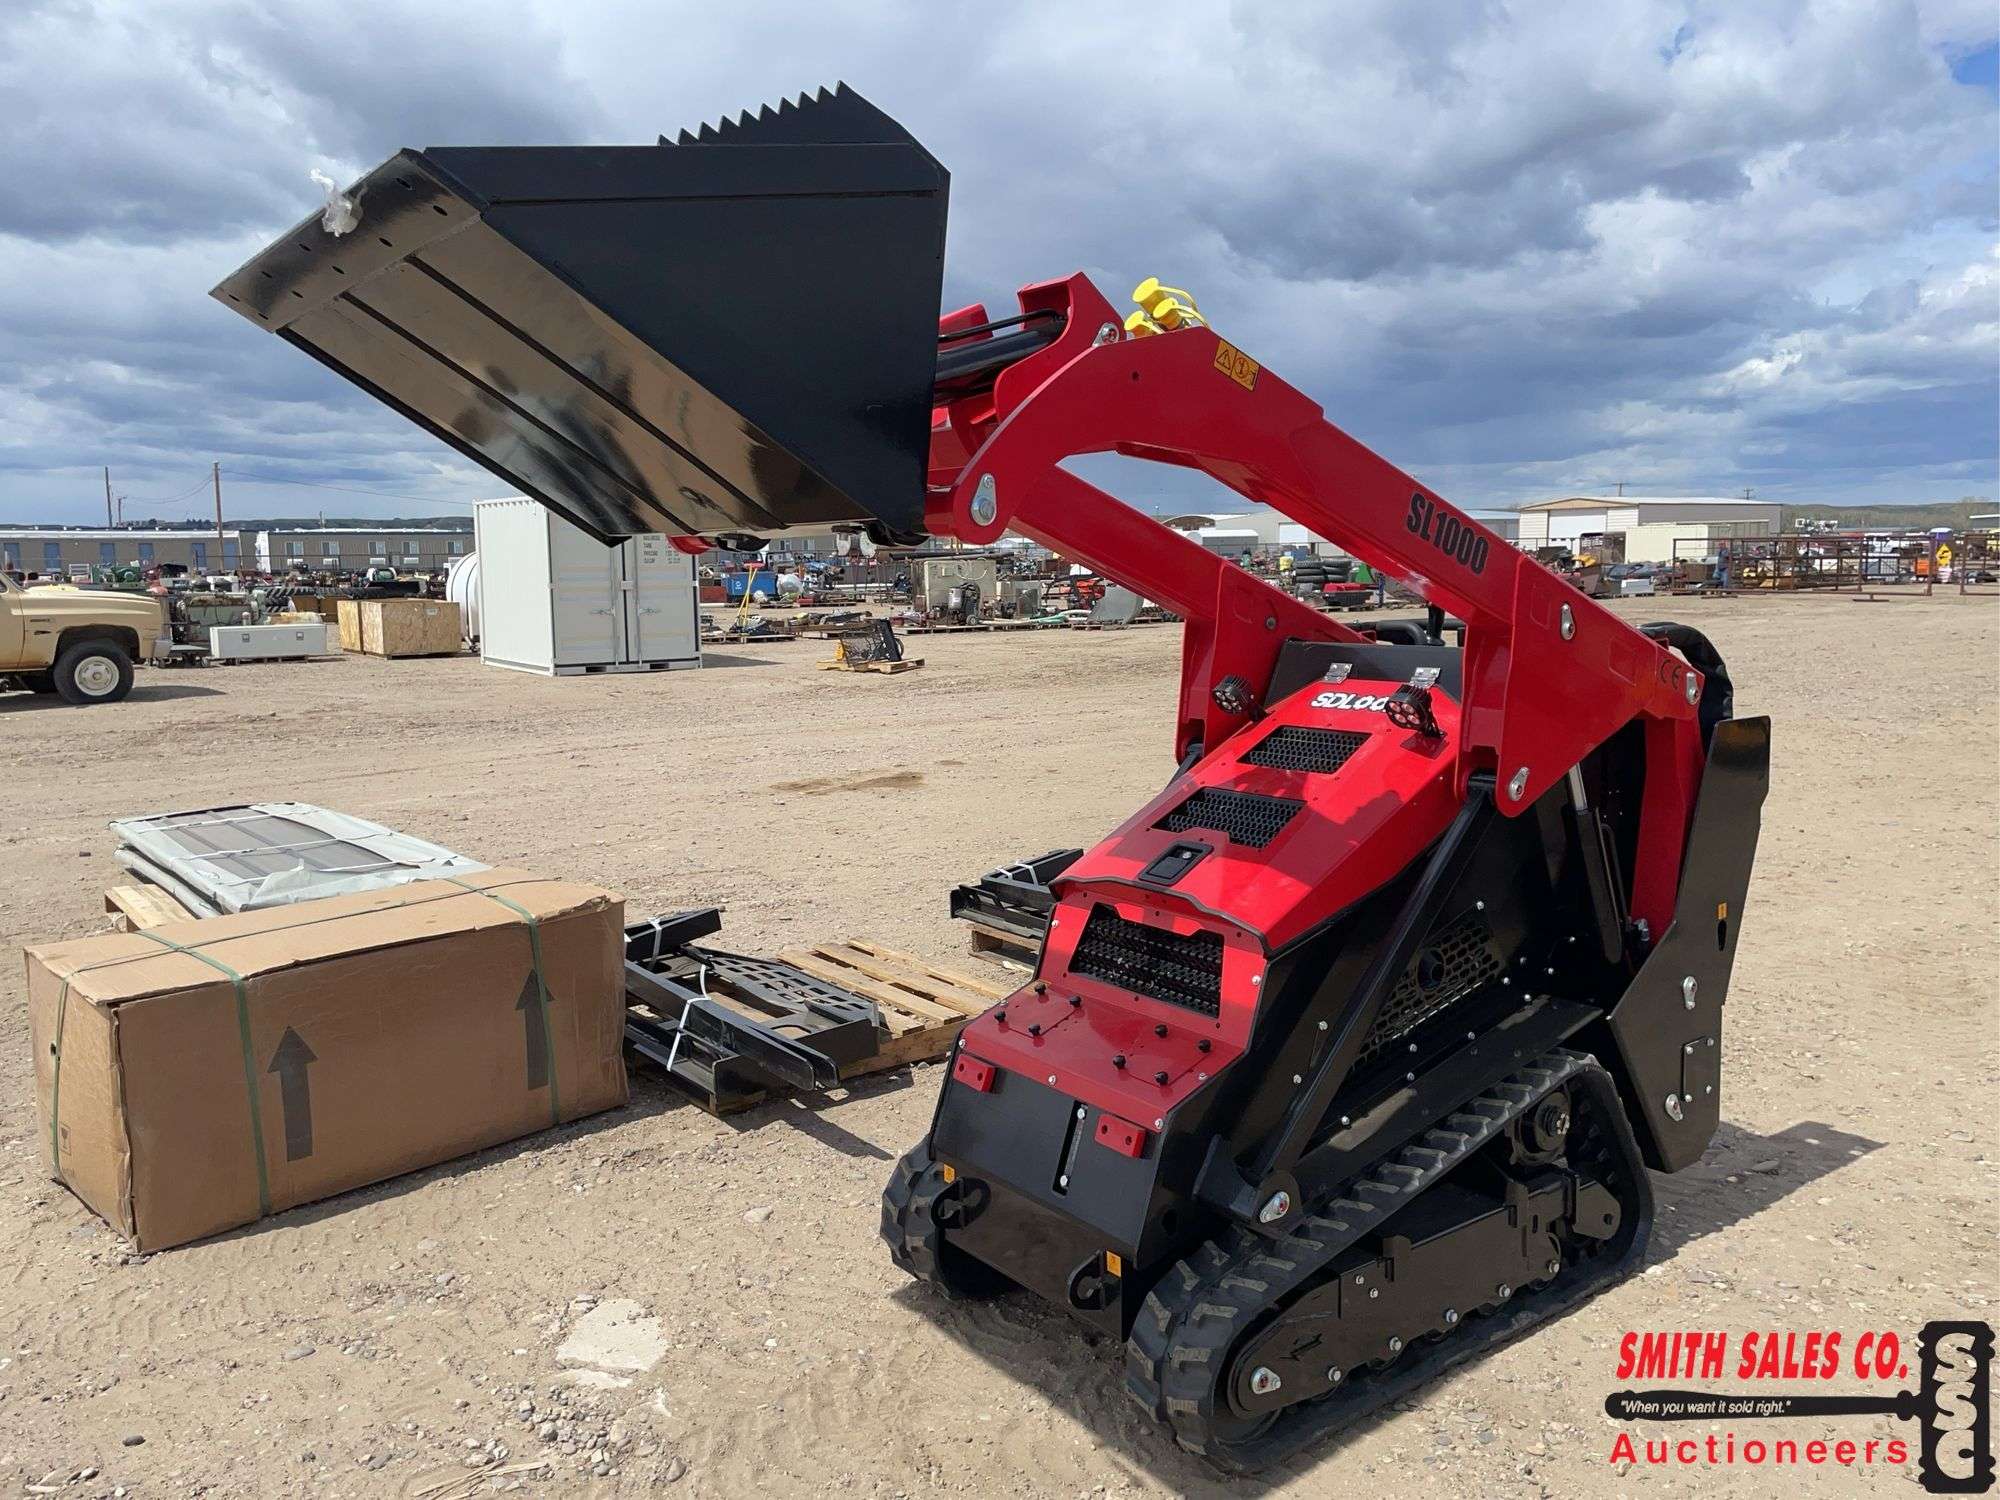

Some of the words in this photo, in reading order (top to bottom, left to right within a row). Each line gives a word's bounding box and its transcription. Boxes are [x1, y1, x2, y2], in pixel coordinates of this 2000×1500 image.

[1407, 492, 1489, 574] SL1000
[1659, 658, 1682, 691] CE
[1310, 691, 1390, 713] SDLOO
